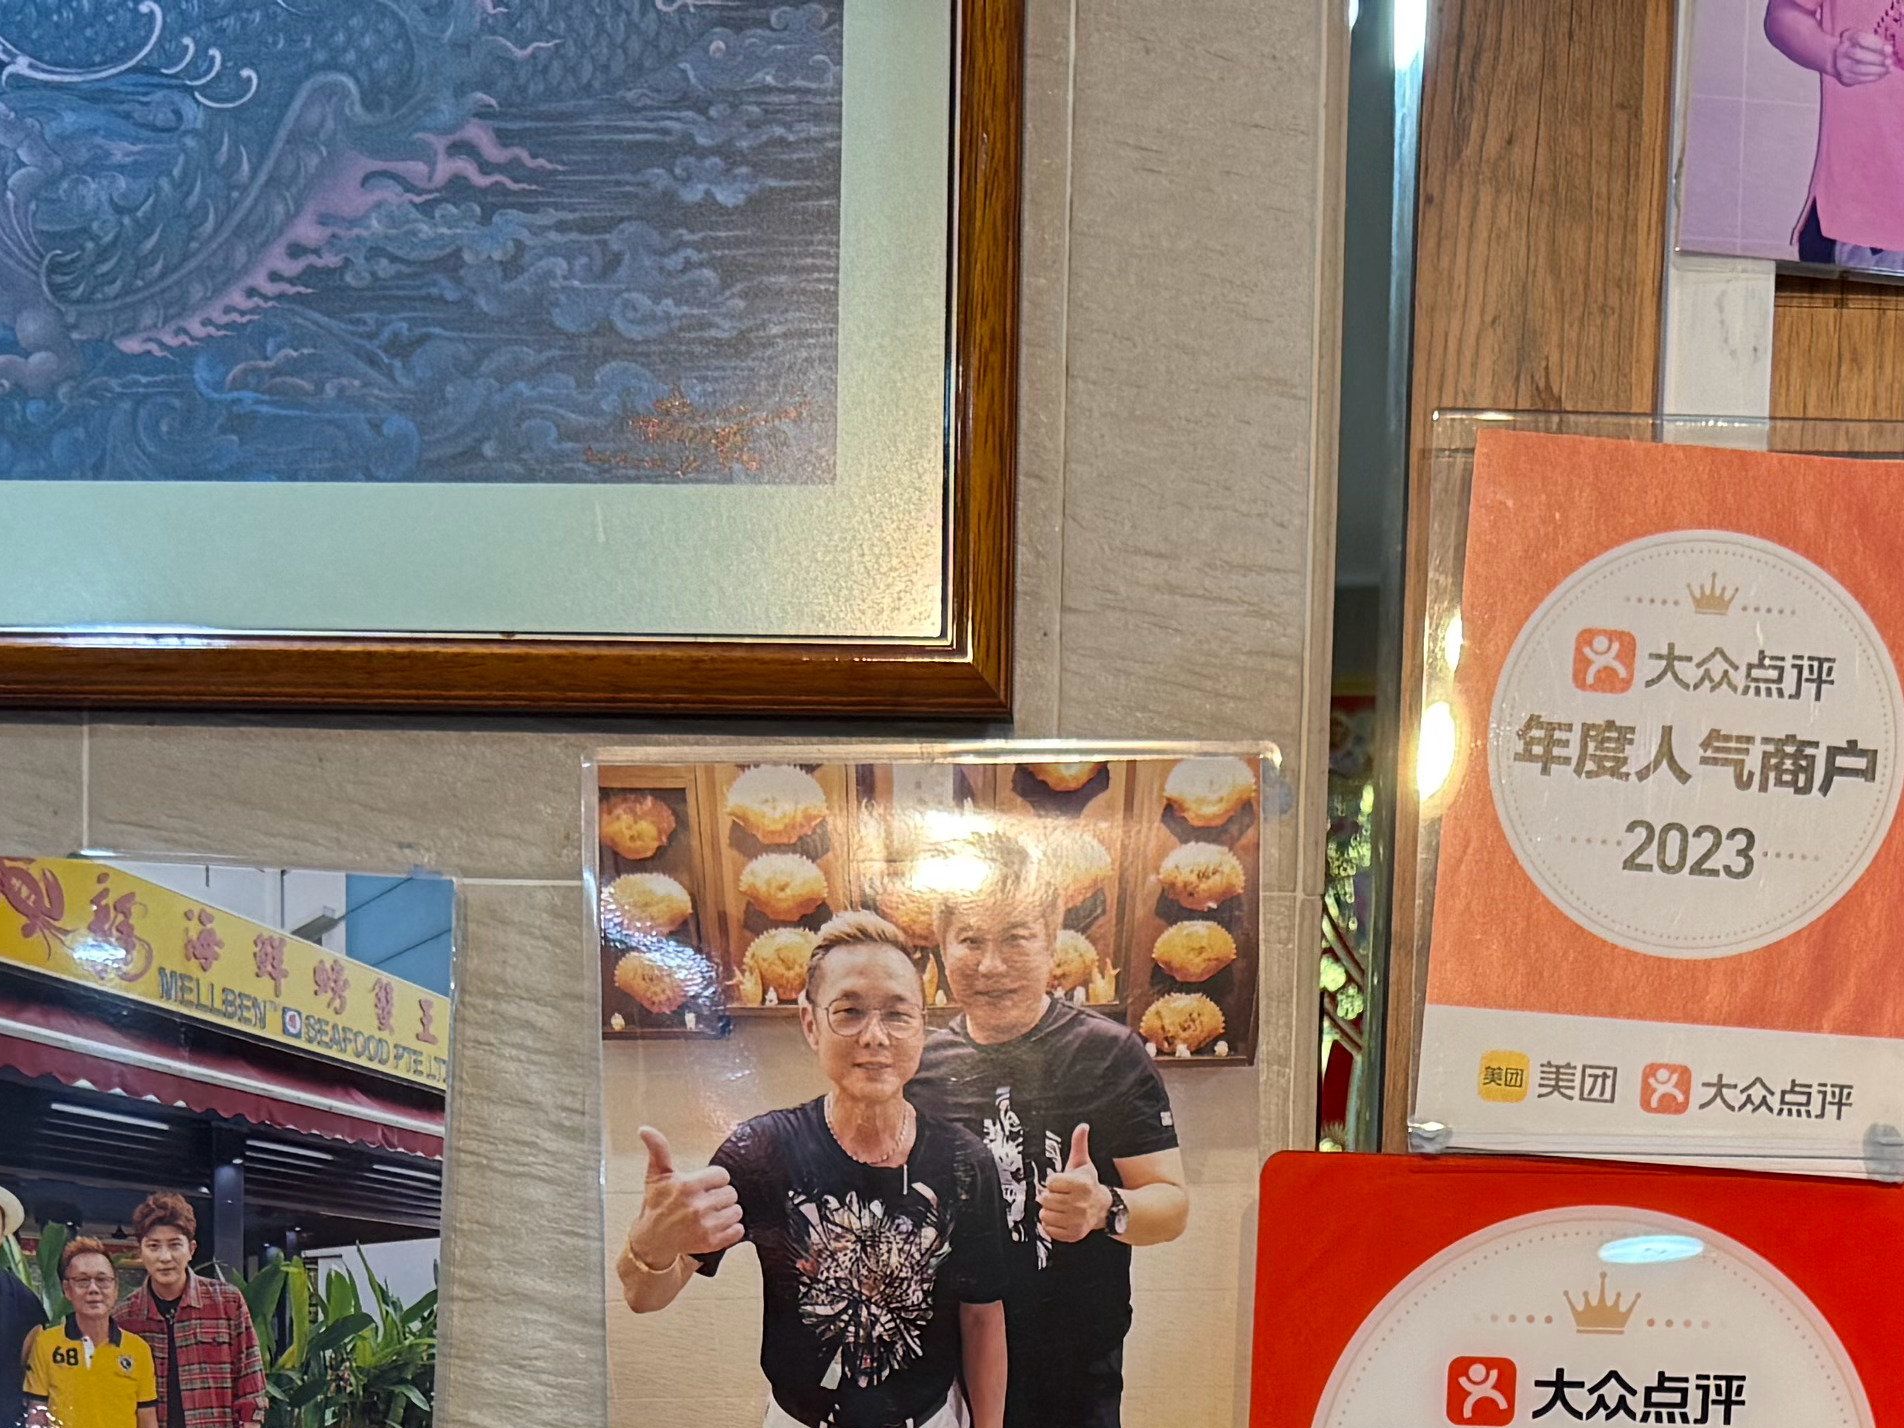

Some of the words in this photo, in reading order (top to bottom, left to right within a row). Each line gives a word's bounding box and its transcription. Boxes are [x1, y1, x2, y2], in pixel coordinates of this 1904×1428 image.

[1645, 642, 1836, 702] 大众点评
[1512, 712, 1880, 799] 年度人气商户
[1621, 819, 1757, 881] 2023
[158, 967, 267, 1030] MELLBEN
[304, 1014, 391, 1066] SEAFOOD
[394, 1043, 424, 1077] PTE
[426, 1054, 448, 1086] LT
[1483, 1064, 1525, 1090] 美团
[1536, 1060, 1618, 1106] 美团
[1698, 1074, 1855, 1121] 大众点评
[51, 1343, 80, 1368] 68
[1532, 1367, 1748, 1428] 大众点评
